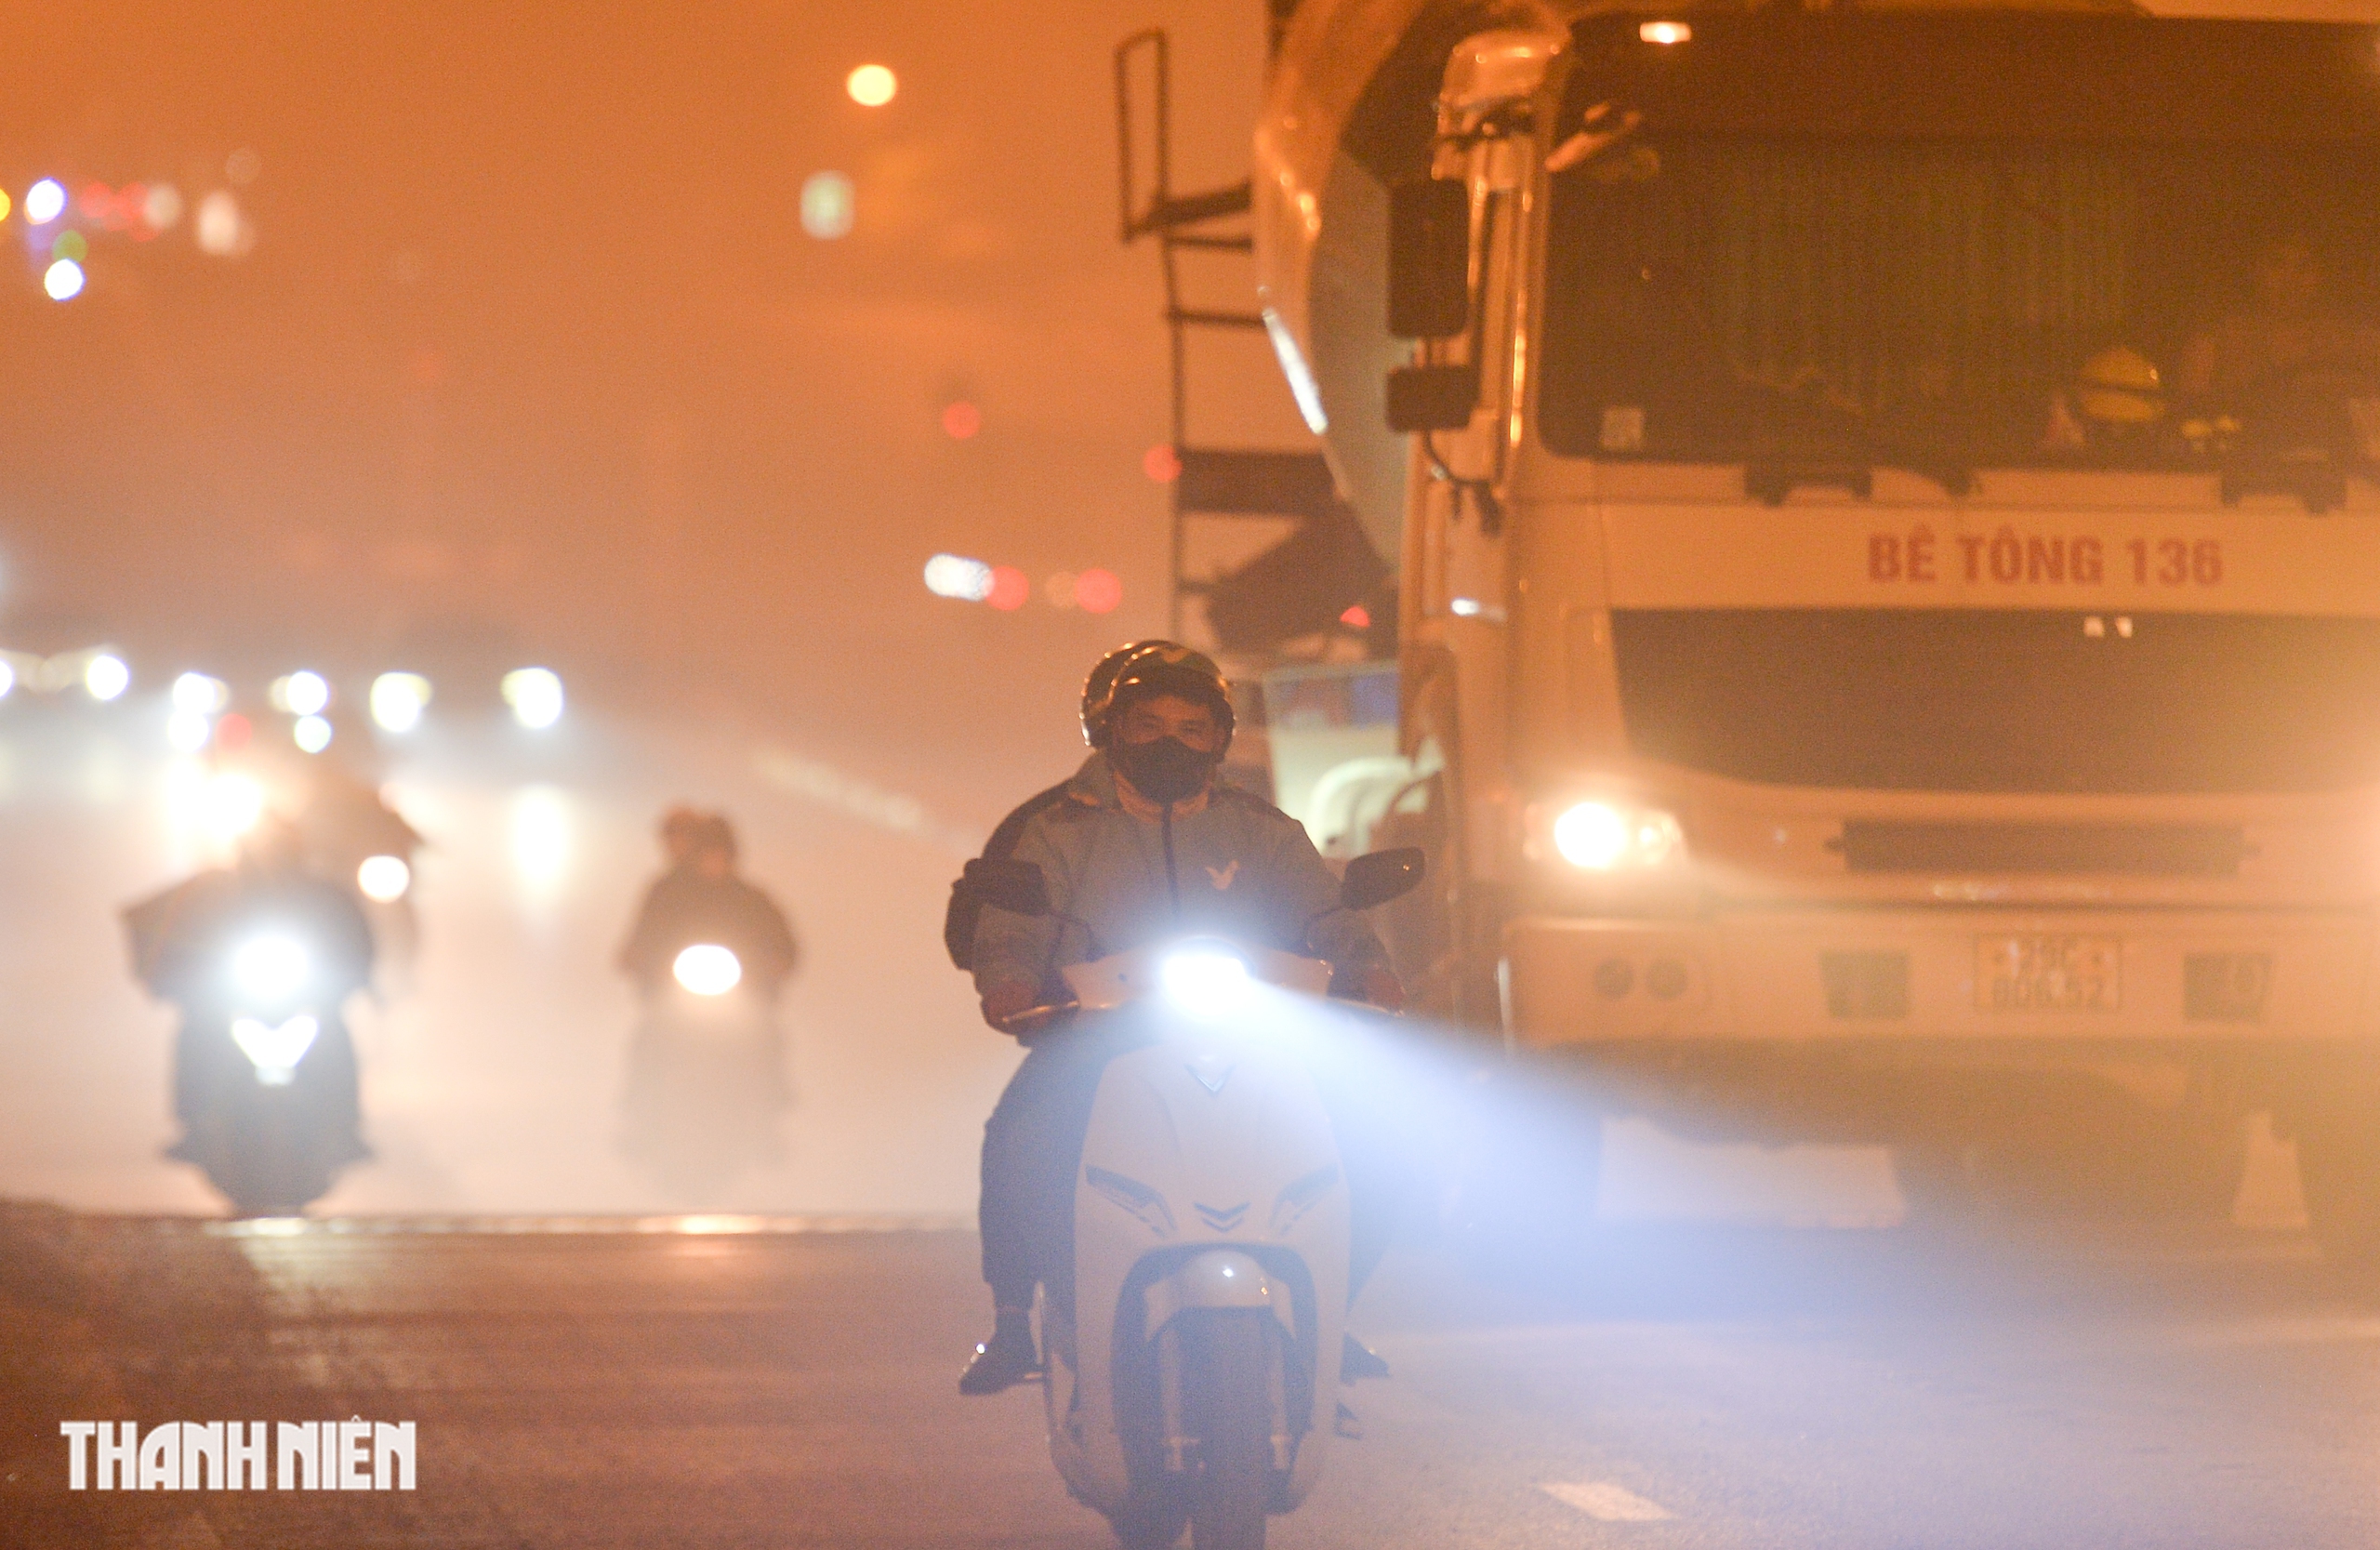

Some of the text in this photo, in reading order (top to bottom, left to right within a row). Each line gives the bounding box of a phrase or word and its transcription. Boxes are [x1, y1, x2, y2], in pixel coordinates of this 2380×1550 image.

[1868, 523, 2224, 587] BÊ TÔNG 136
